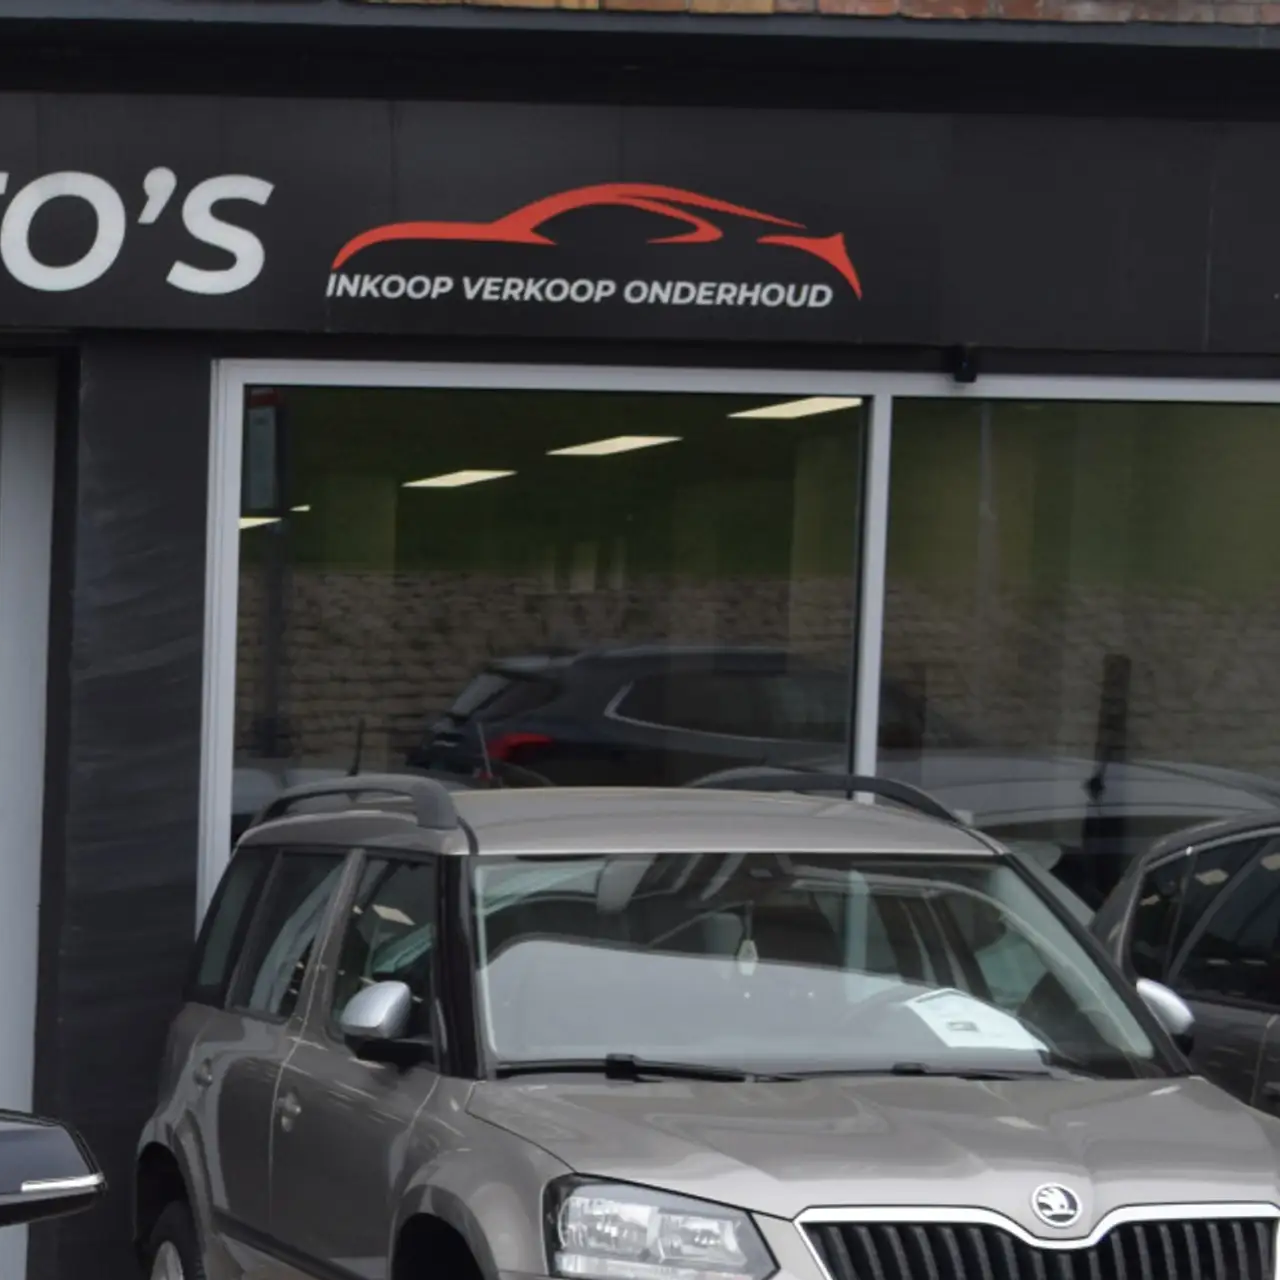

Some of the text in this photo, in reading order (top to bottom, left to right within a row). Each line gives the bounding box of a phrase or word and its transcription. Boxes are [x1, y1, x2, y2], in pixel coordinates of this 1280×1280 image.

[326, 273, 833, 308] INKOOP VERKOOP ONDERHOUD
